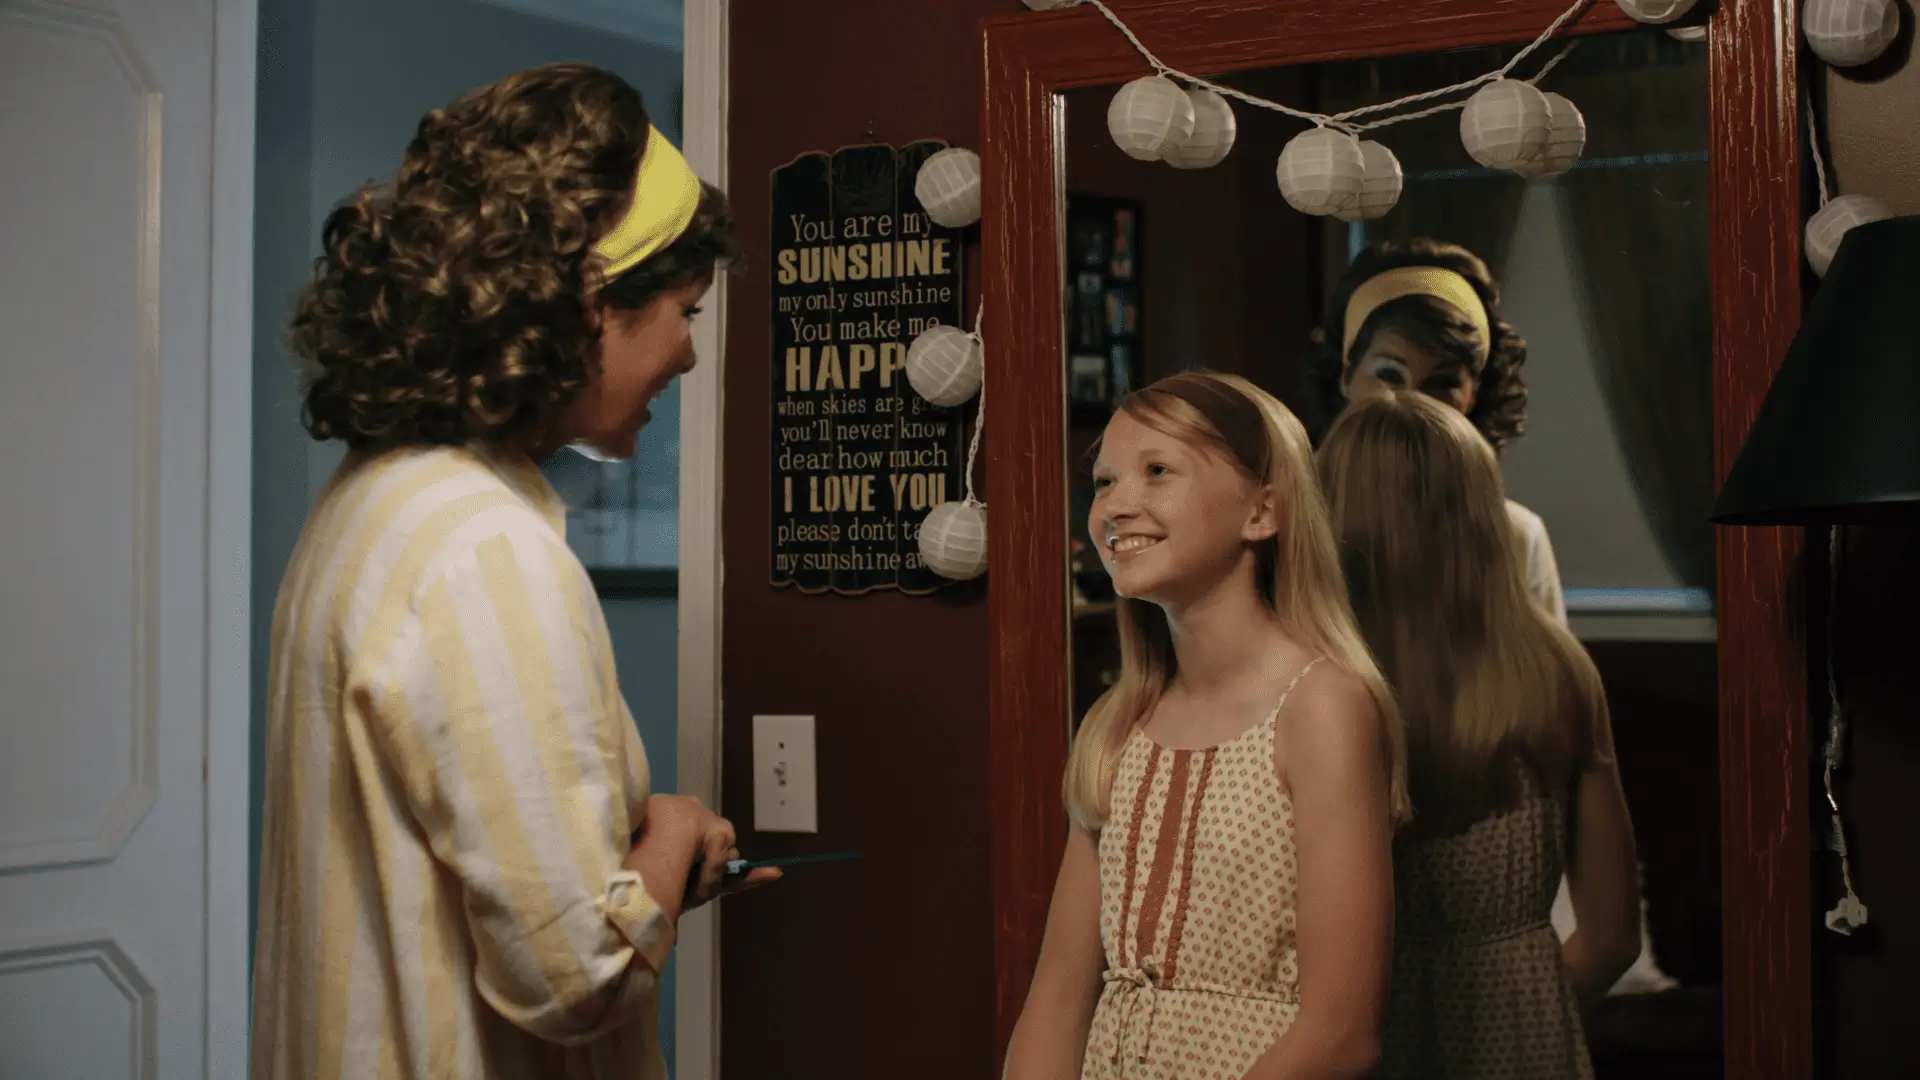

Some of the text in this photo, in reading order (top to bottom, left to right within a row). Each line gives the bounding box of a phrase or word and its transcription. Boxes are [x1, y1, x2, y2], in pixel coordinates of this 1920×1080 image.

[790, 212, 932, 242] You are my
[778, 238, 951, 285] SUNSHINE
[779, 283, 951, 315] my only sunshine
[790, 312, 940, 342] You make me
[785, 343, 906, 392] HAPP
[777, 396, 815, 416] when
[822, 394, 866, 415] skies
[875, 398, 904, 413] are
[780, 417, 948, 446] you'll never know
[779, 443, 948, 470] dear how much
[784, 473, 946, 513] I LOVE YOU
[777, 517, 920, 546] please don't ta
[777, 554, 801, 574] my
[803, 546, 901, 570] sunshine
